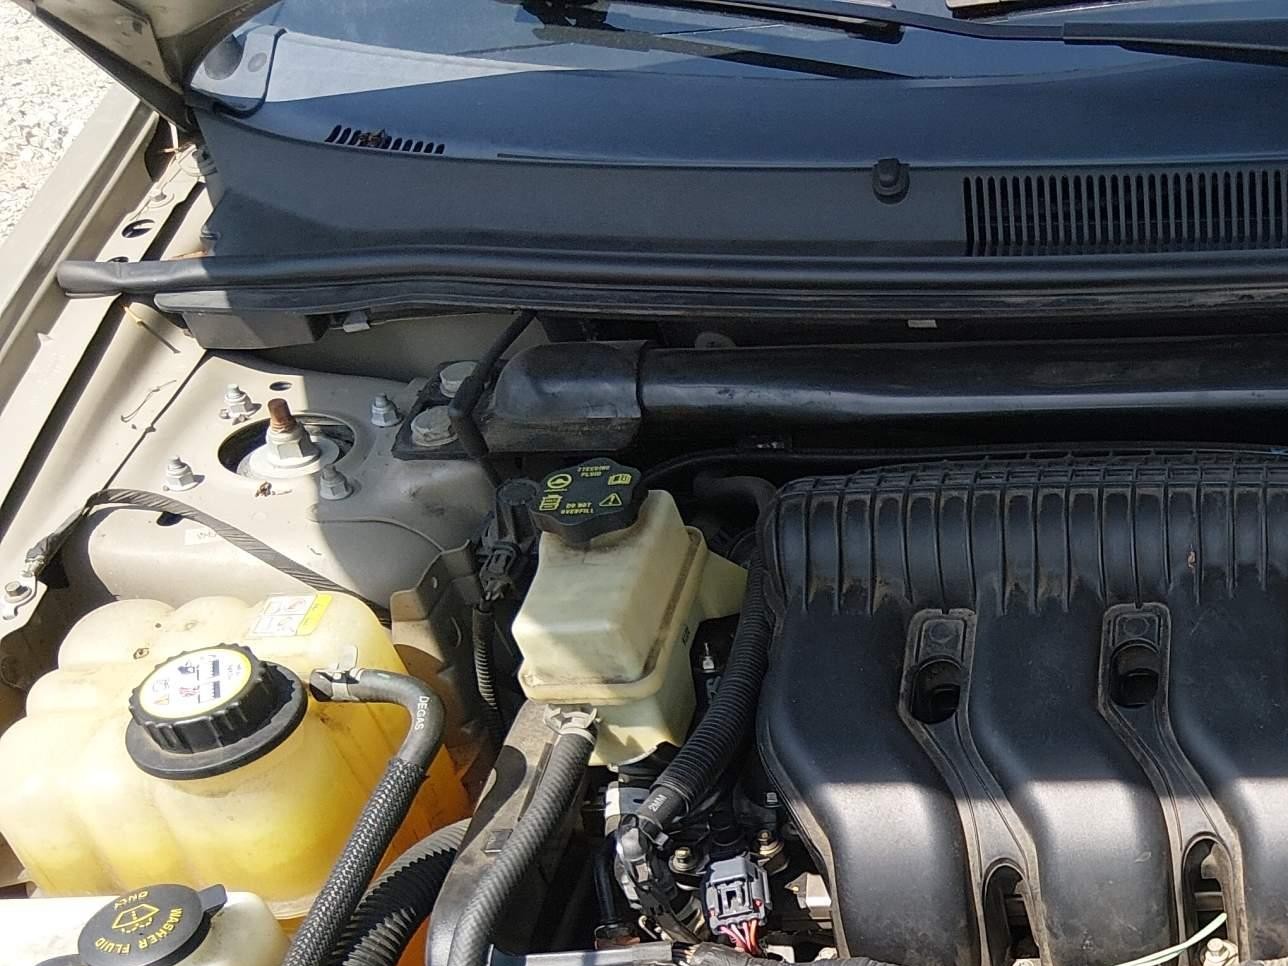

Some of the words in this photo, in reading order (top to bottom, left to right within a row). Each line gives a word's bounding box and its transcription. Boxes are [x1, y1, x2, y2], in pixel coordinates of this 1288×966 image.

[414, 695, 430, 730] DEGAS
[113, 891, 149, 911] ONLY
[138, 907, 184, 949] WASHER
[95, 937, 131, 955] FLUID
